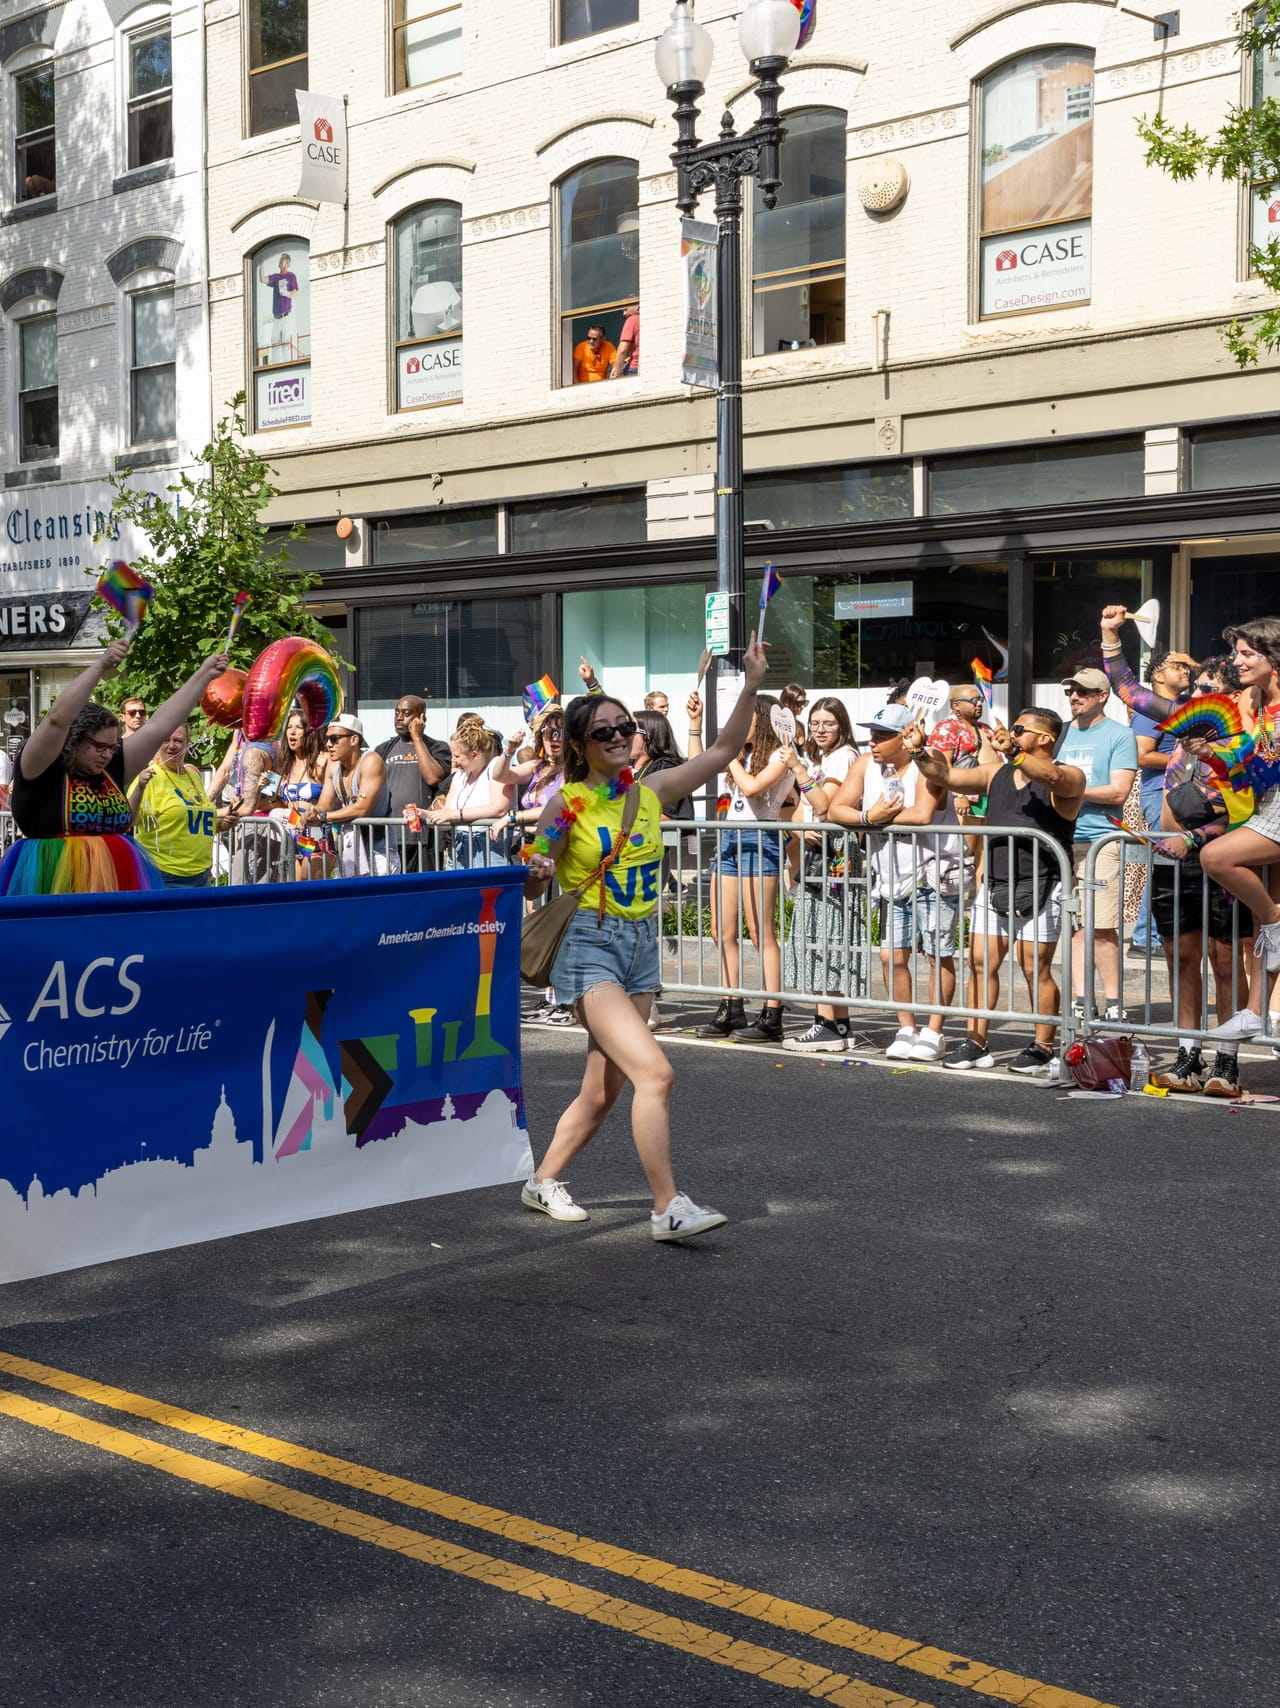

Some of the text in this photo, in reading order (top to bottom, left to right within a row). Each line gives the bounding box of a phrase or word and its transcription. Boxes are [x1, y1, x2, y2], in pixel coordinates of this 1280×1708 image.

[307, 143, 342, 165] CASE
[1020, 235, 1084, 266] CASE
[994, 287, 1086, 310] CaseDesign.com
[421, 348, 461, 371] CASE
[269, 376, 304, 405] fred
[58, 555, 81, 566] 1890
[911, 693, 940, 706] PRIDE
[69, 812, 104, 824] LOVE
[377, 920, 507, 946] American Chemical Society
[26, 954, 145, 1022] ACS
[23, 1035, 140, 1072] Chemistry
[142, 1028, 174, 1057] for
